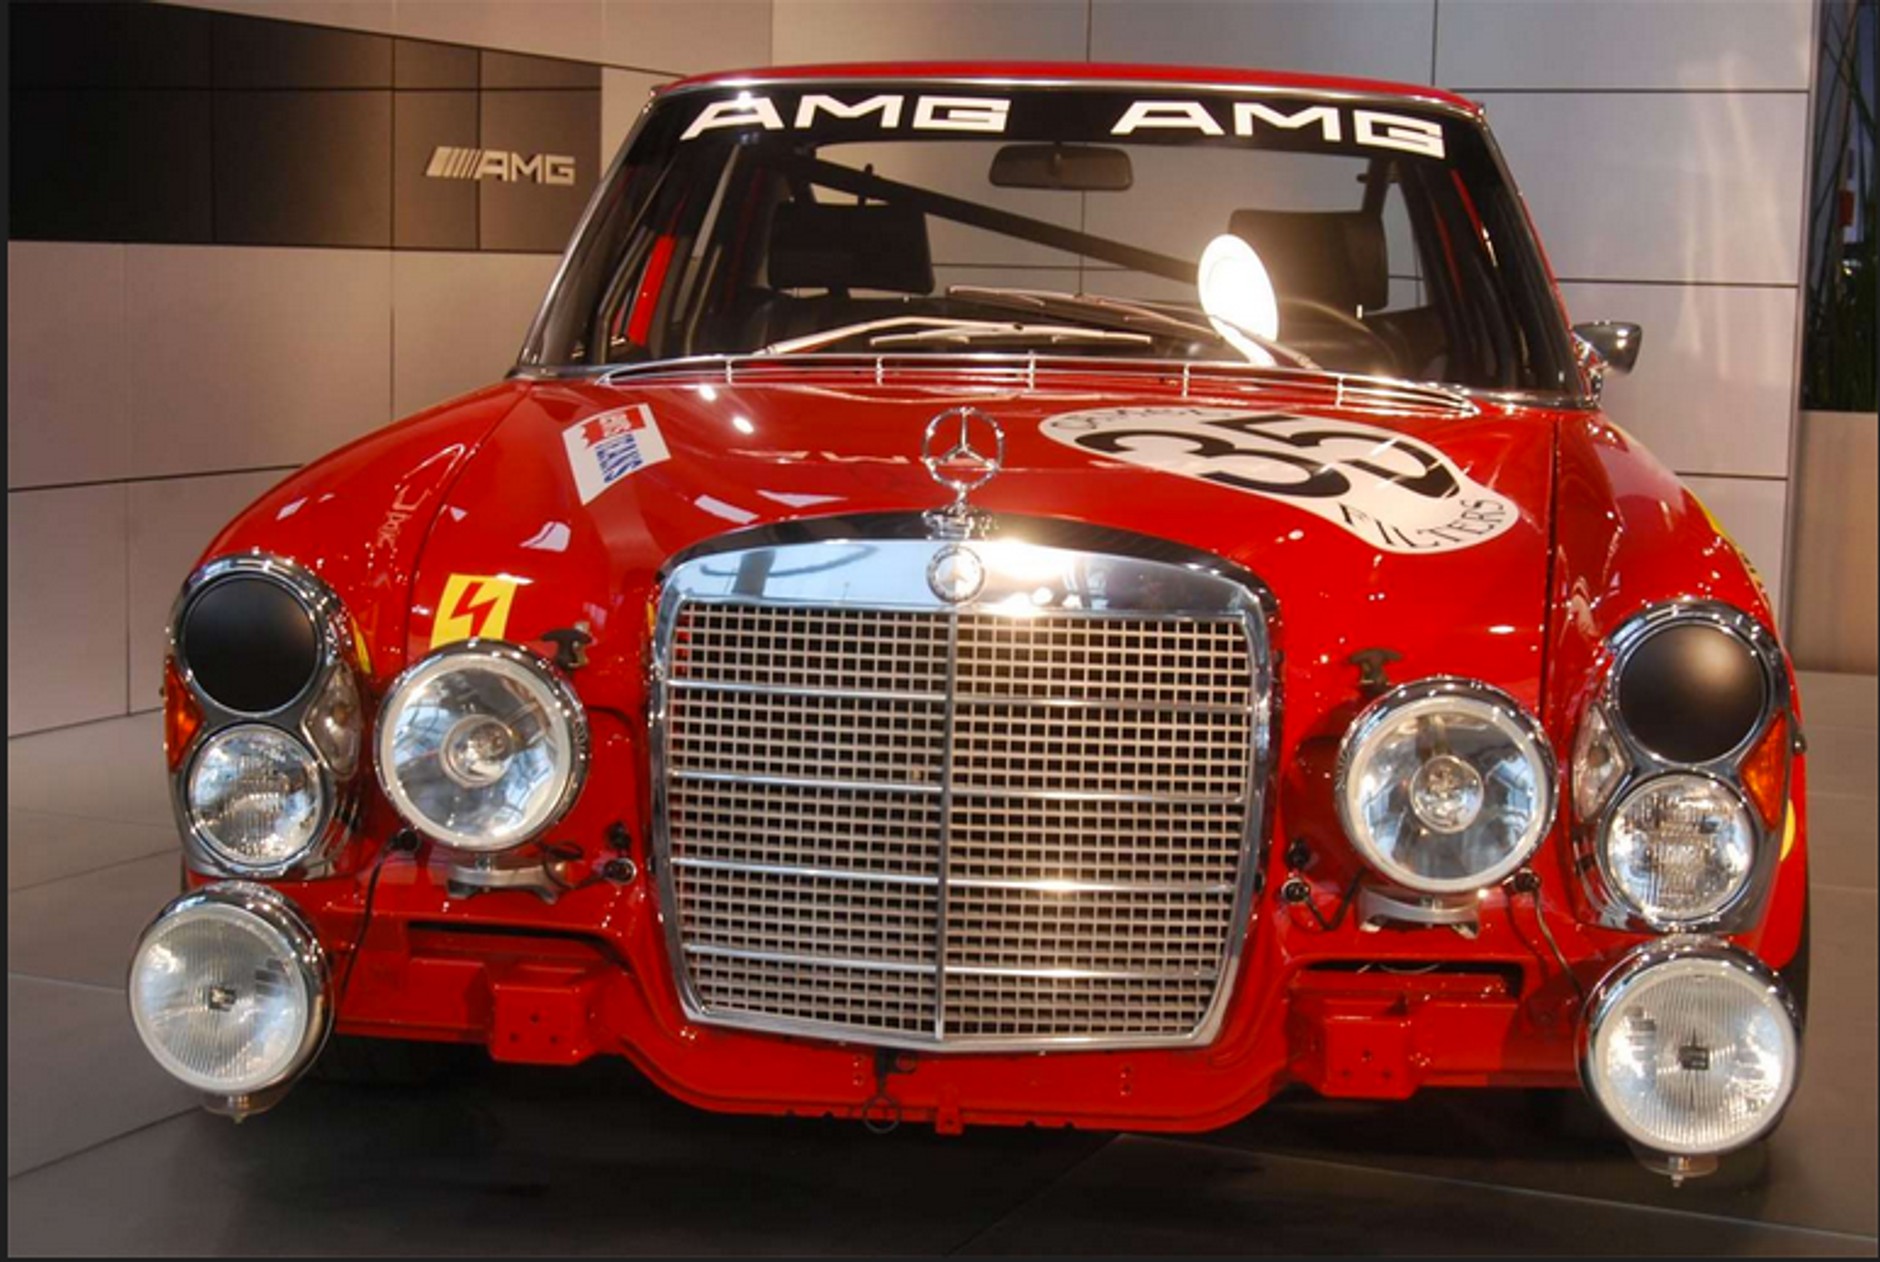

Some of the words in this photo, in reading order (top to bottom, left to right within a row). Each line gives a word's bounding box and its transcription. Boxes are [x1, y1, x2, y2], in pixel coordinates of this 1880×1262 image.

[679, 94, 1012, 141] AMG
[1109, 101, 1446, 160] AMG
[473, 150, 576, 186] AMG
[1074, 414, 1461, 499] 35
[1338, 499, 1506, 548] FILTERS
